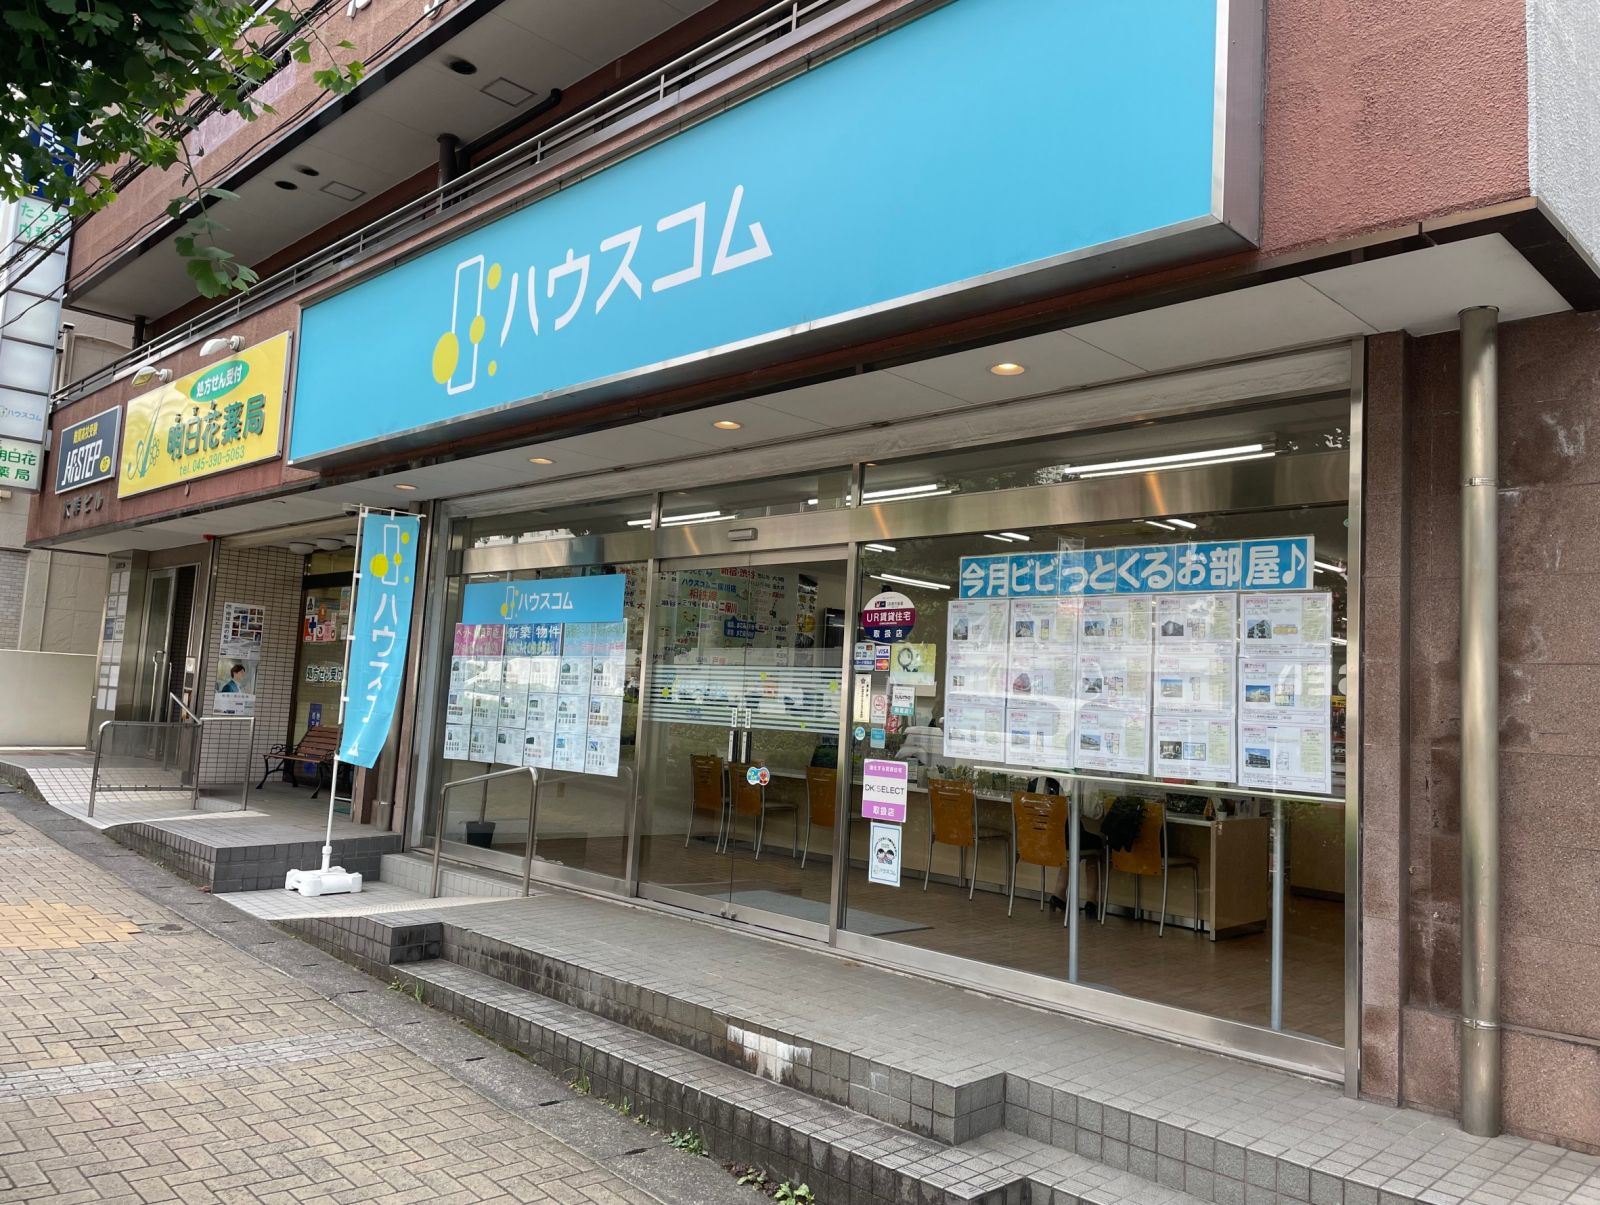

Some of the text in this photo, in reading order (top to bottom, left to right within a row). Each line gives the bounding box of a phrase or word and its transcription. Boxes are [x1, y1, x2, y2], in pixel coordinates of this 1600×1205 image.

[500, 184, 773, 348] ハウスコム
[196, 363, 243, 398] 処方せん受付
[167, 394, 266, 461] 明日花薬局
[518, 592, 573, 611] ハウスコム
[866, 611, 912, 622] UR賃貸住宅
